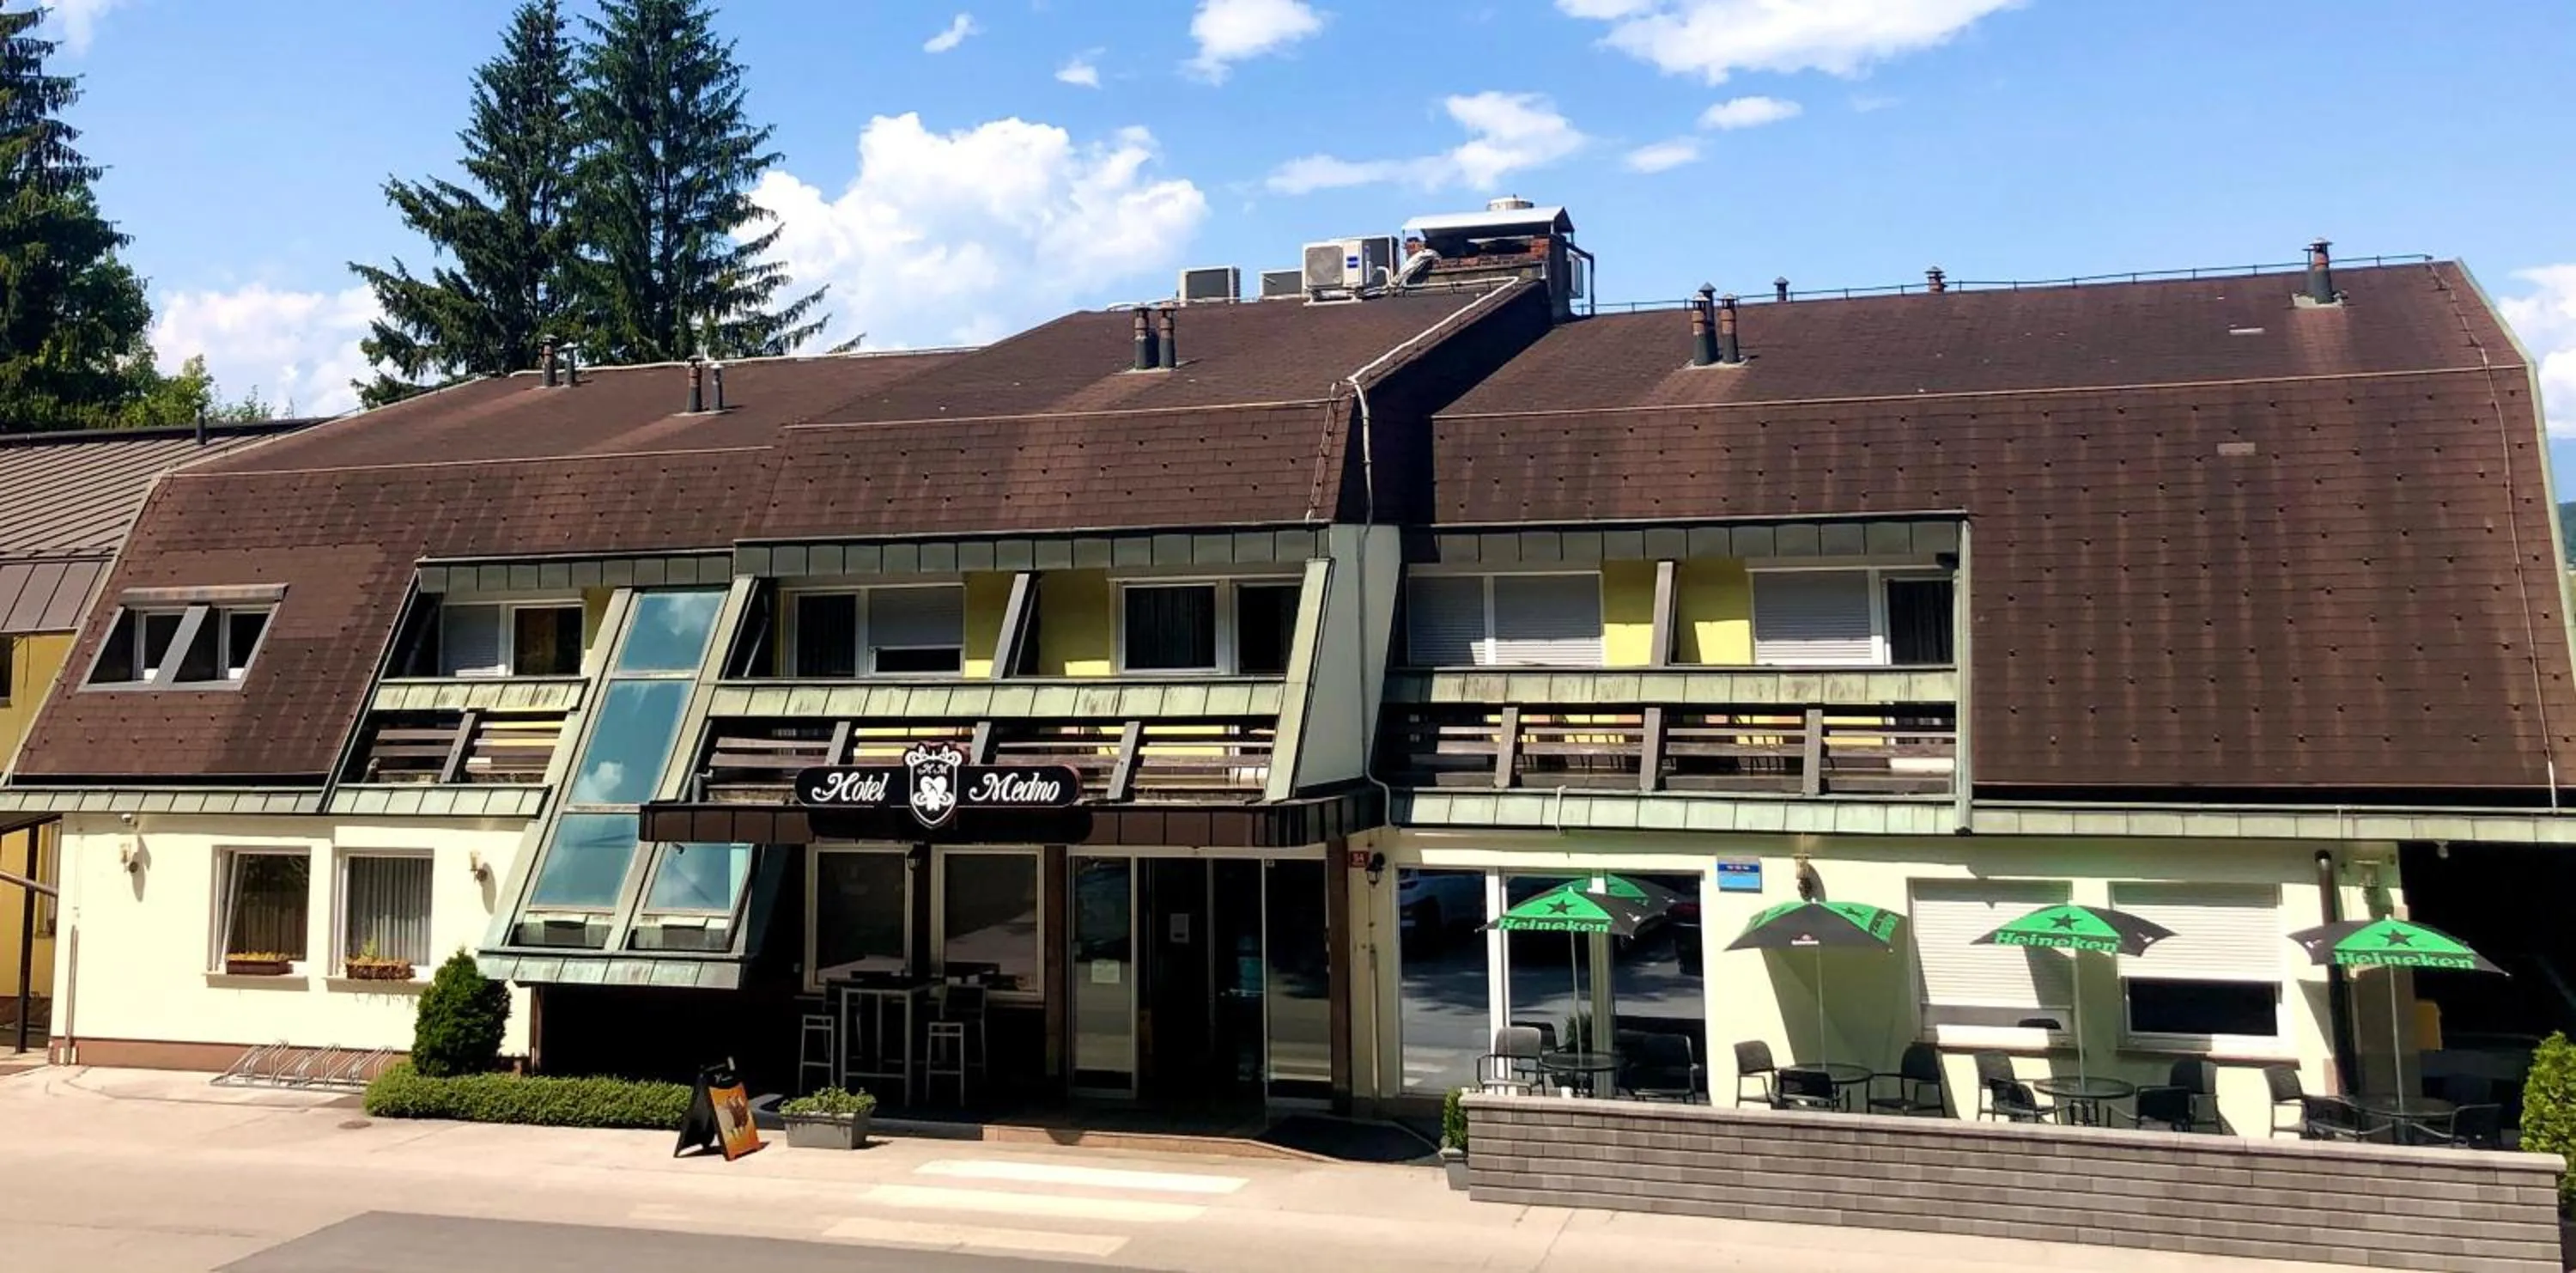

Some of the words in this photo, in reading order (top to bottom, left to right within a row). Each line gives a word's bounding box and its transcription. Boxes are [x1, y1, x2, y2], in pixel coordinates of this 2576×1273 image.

[811, 771, 890, 802] Hotel
[968, 772, 1060, 801] Medno
[1498, 918, 1610, 933] Heineken
[1994, 930, 2117, 953] Heineken
[2335, 951, 2474, 969] Heineken
